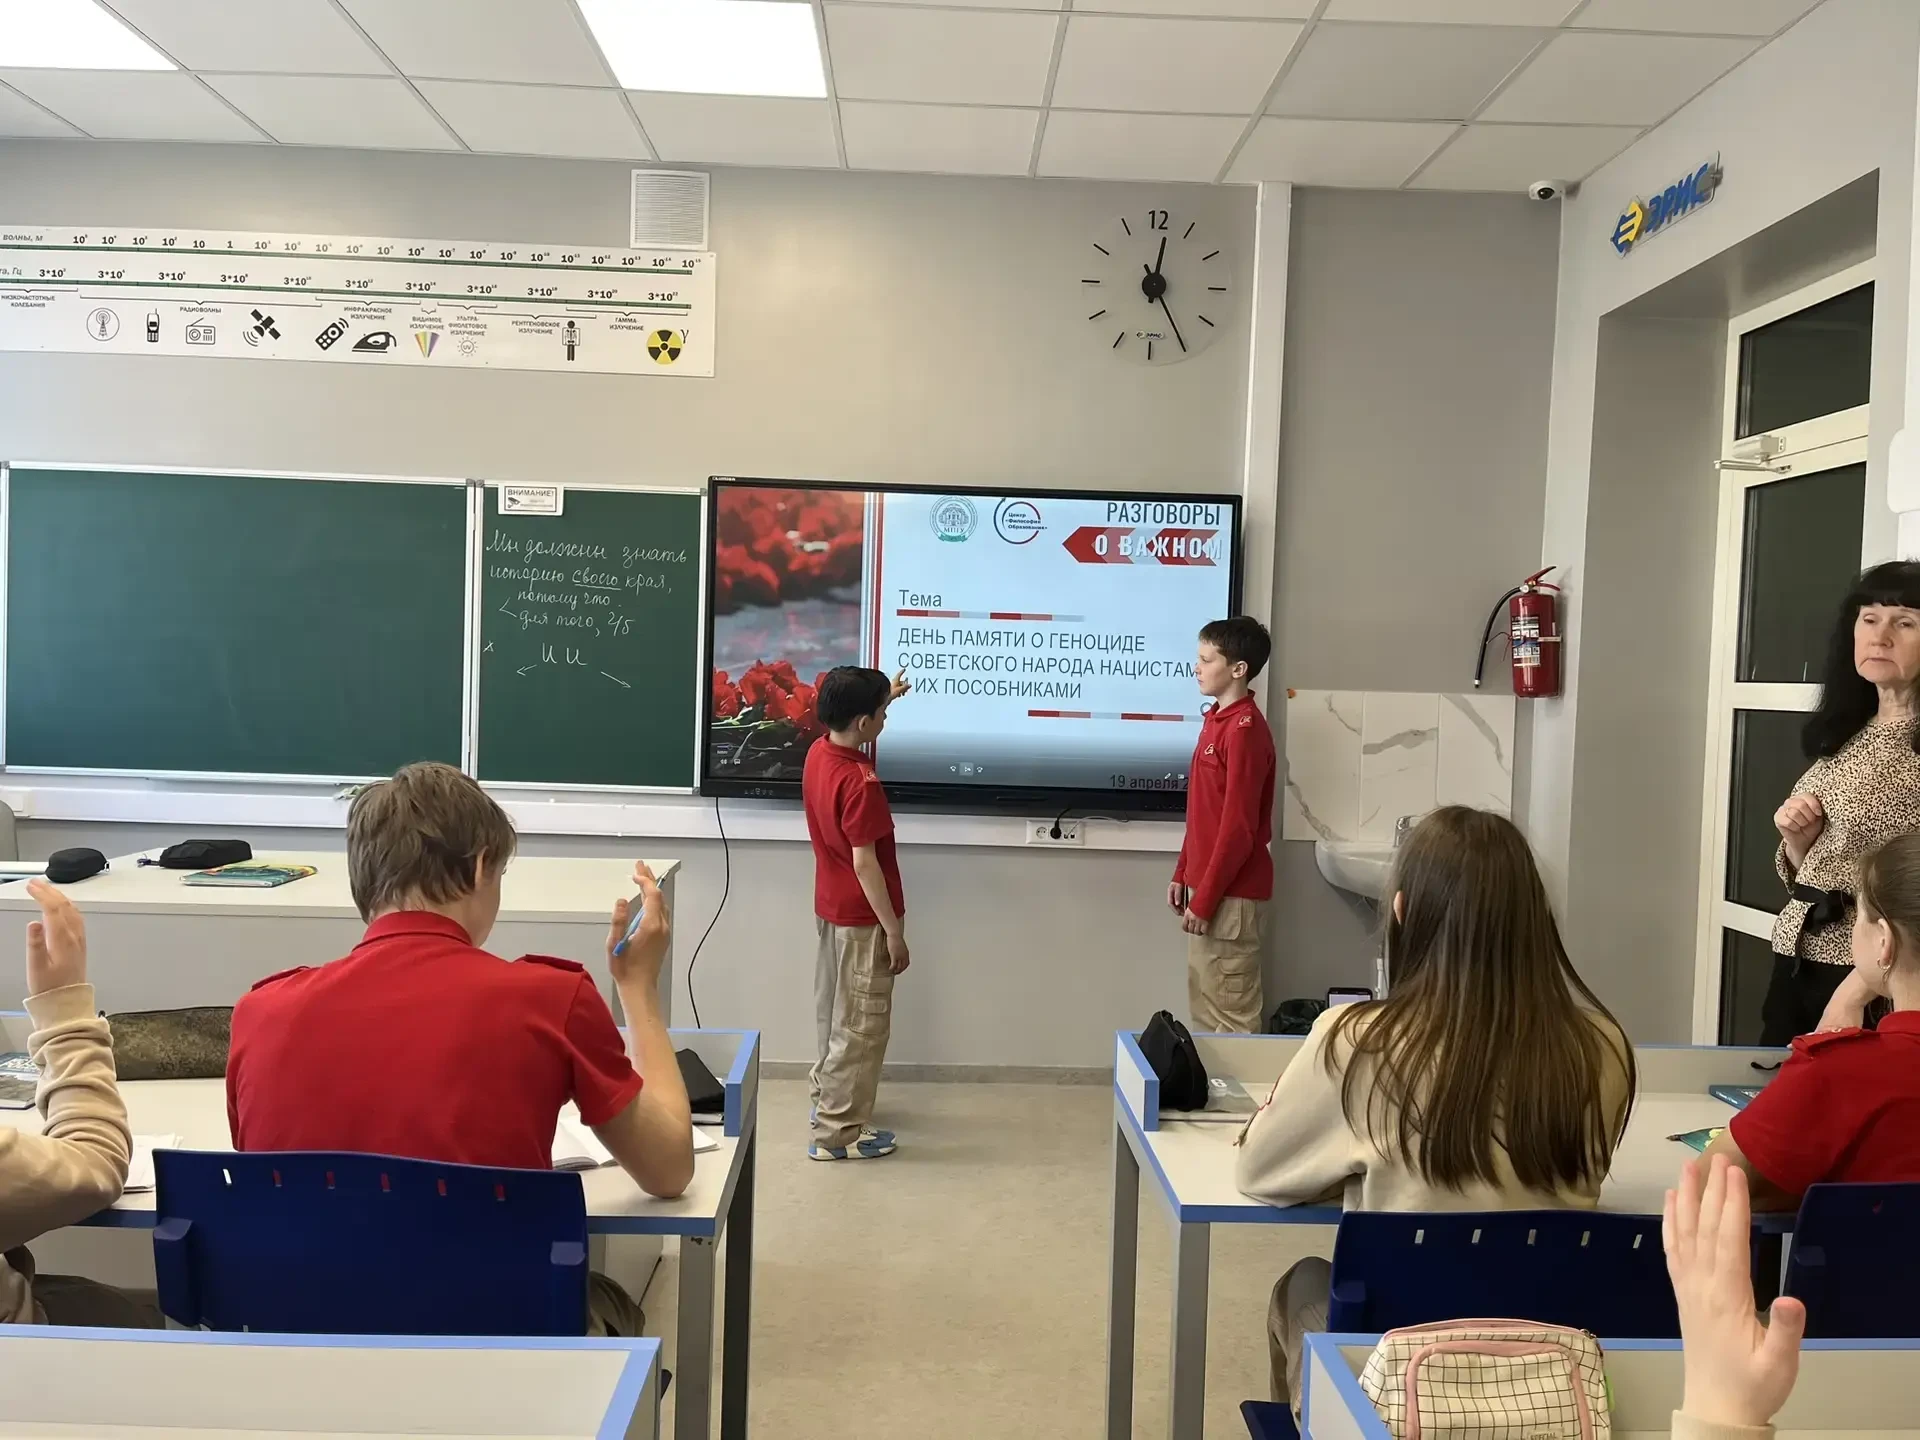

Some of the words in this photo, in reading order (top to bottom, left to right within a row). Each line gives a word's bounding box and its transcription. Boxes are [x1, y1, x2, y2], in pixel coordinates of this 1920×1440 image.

[1645, 162, 1709, 234] ЭРИС
[1148, 210, 1169, 230] 12
[193, 240, 205, 248] 10
[227, 240, 232, 248] 1
[180, 306, 222, 314] РАДИОВОЛНЫ
[344, 306, 392, 314] ИНФРАКРАСНОЕ
[1106, 502, 1220, 526] РАЗГОВОРЫ
[622, 545, 688, 568] знать
[1094, 534, 1108, 556] О
[1119, 534, 1222, 559] ВАЖНОМ
[490, 564, 564, 591] историю
[572, 567, 618, 587] своего
[518, 590, 578, 610] потому
[898, 589, 942, 608] Тема
[520, 608, 548, 630] для
[897, 627, 945, 648] ДЕНЬ
[951, 629, 1025, 648] ПАМЯТИ
[1031, 631, 1044, 649] О
[1050, 633, 1145, 653] ГЕНОЦИДЕ
[898, 652, 1017, 674] СОВЕТСКОГО
[1022, 655, 1095, 676] НАРОДА
[915, 678, 938, 695] ИХ
[944, 679, 1082, 699] ПОСОБНИКАМИ
[1110, 774, 1125, 788] 19
[1130, 778, 1178, 790] апреля
